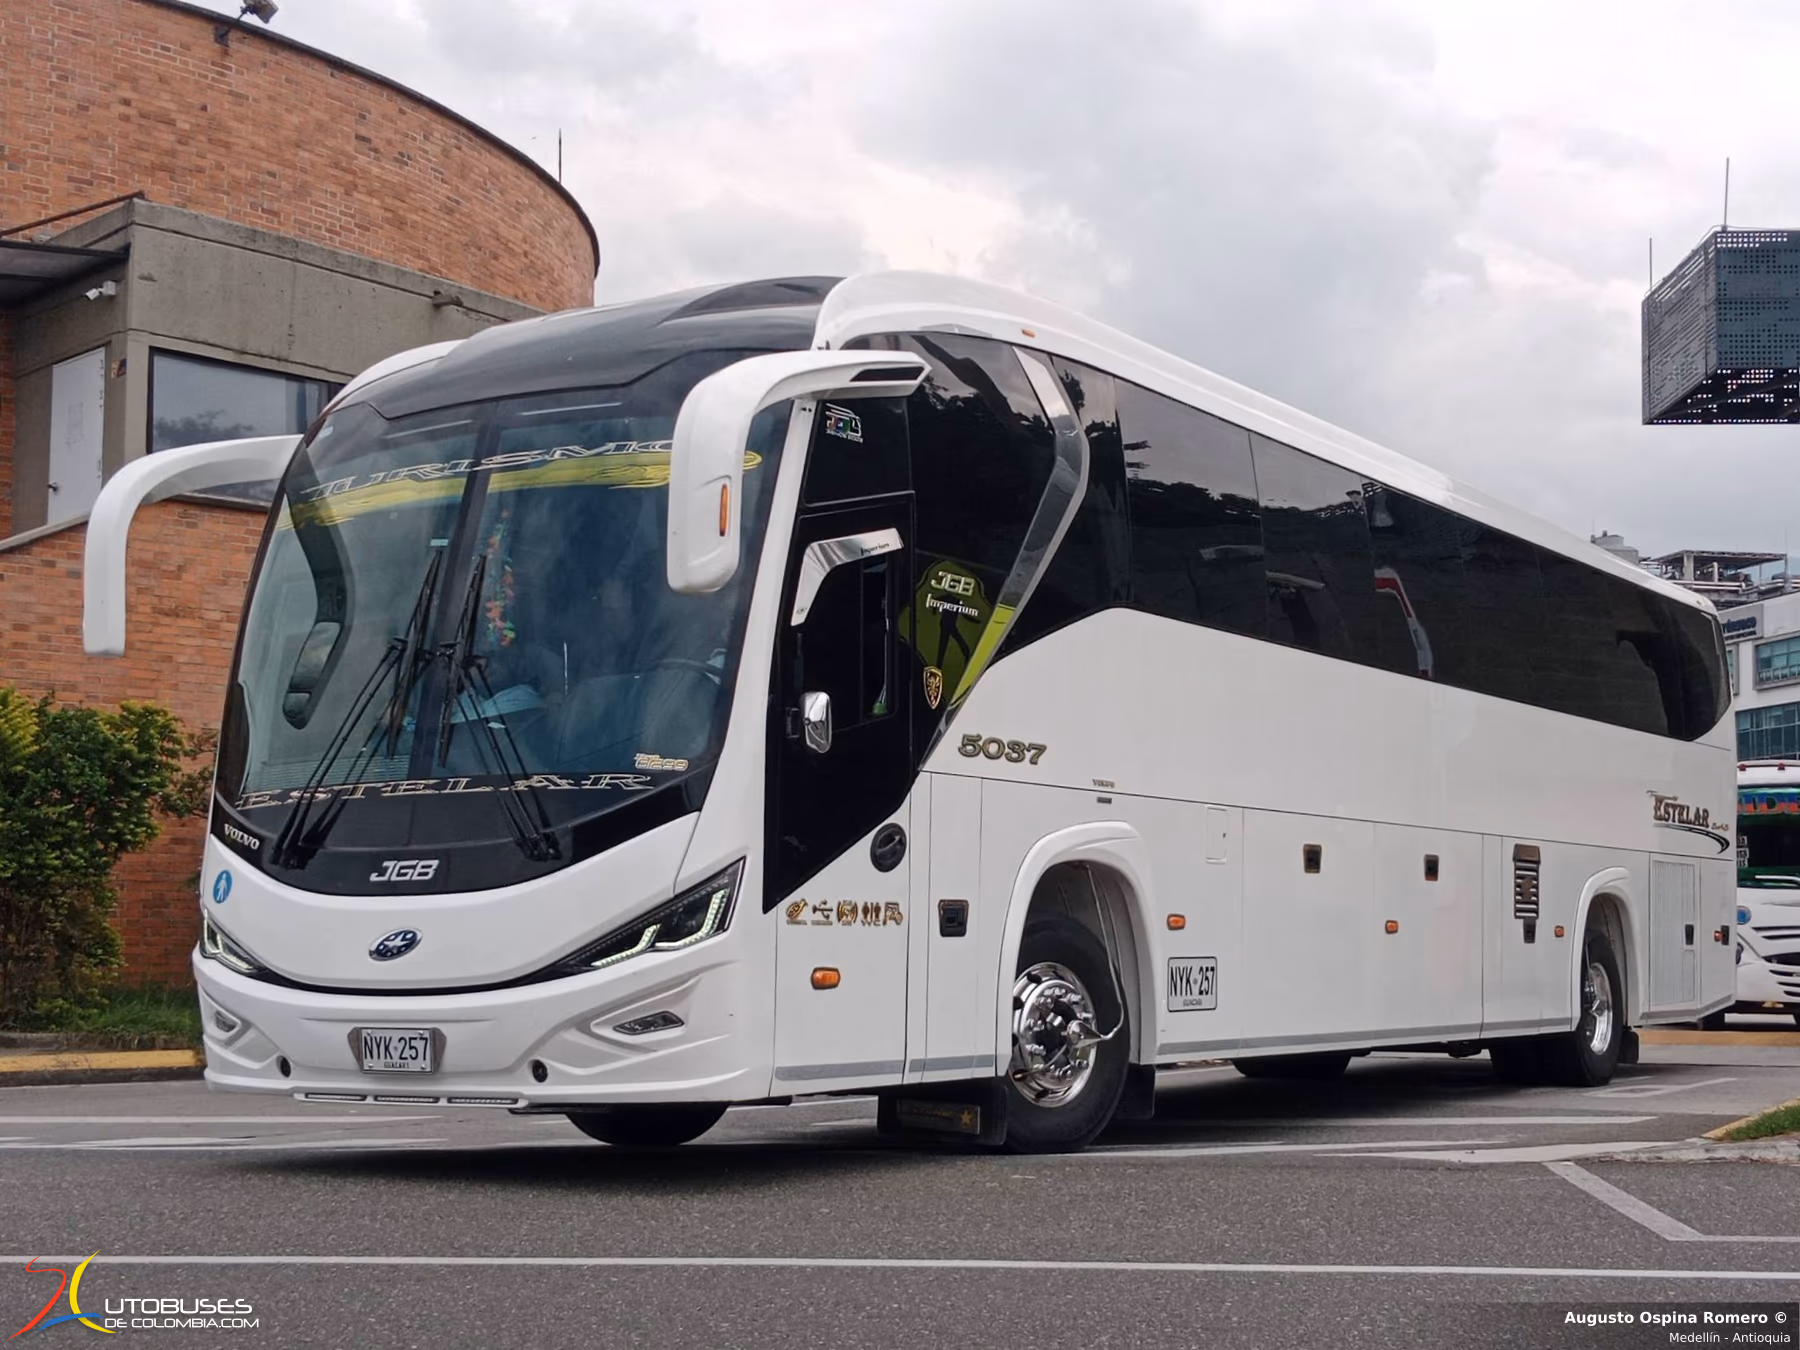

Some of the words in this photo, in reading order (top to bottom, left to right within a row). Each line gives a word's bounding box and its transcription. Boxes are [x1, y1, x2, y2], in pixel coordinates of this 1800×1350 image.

[930, 570, 976, 597] JGB
[925, 593, 979, 617] Imperium
[957, 733, 1048, 765] 5037
[235, 773, 654, 810] ESTELAR
[1653, 796, 1710, 828] ESTELAR
[223, 822, 261, 851] VOLVO
[369, 859, 440, 882] JGB
